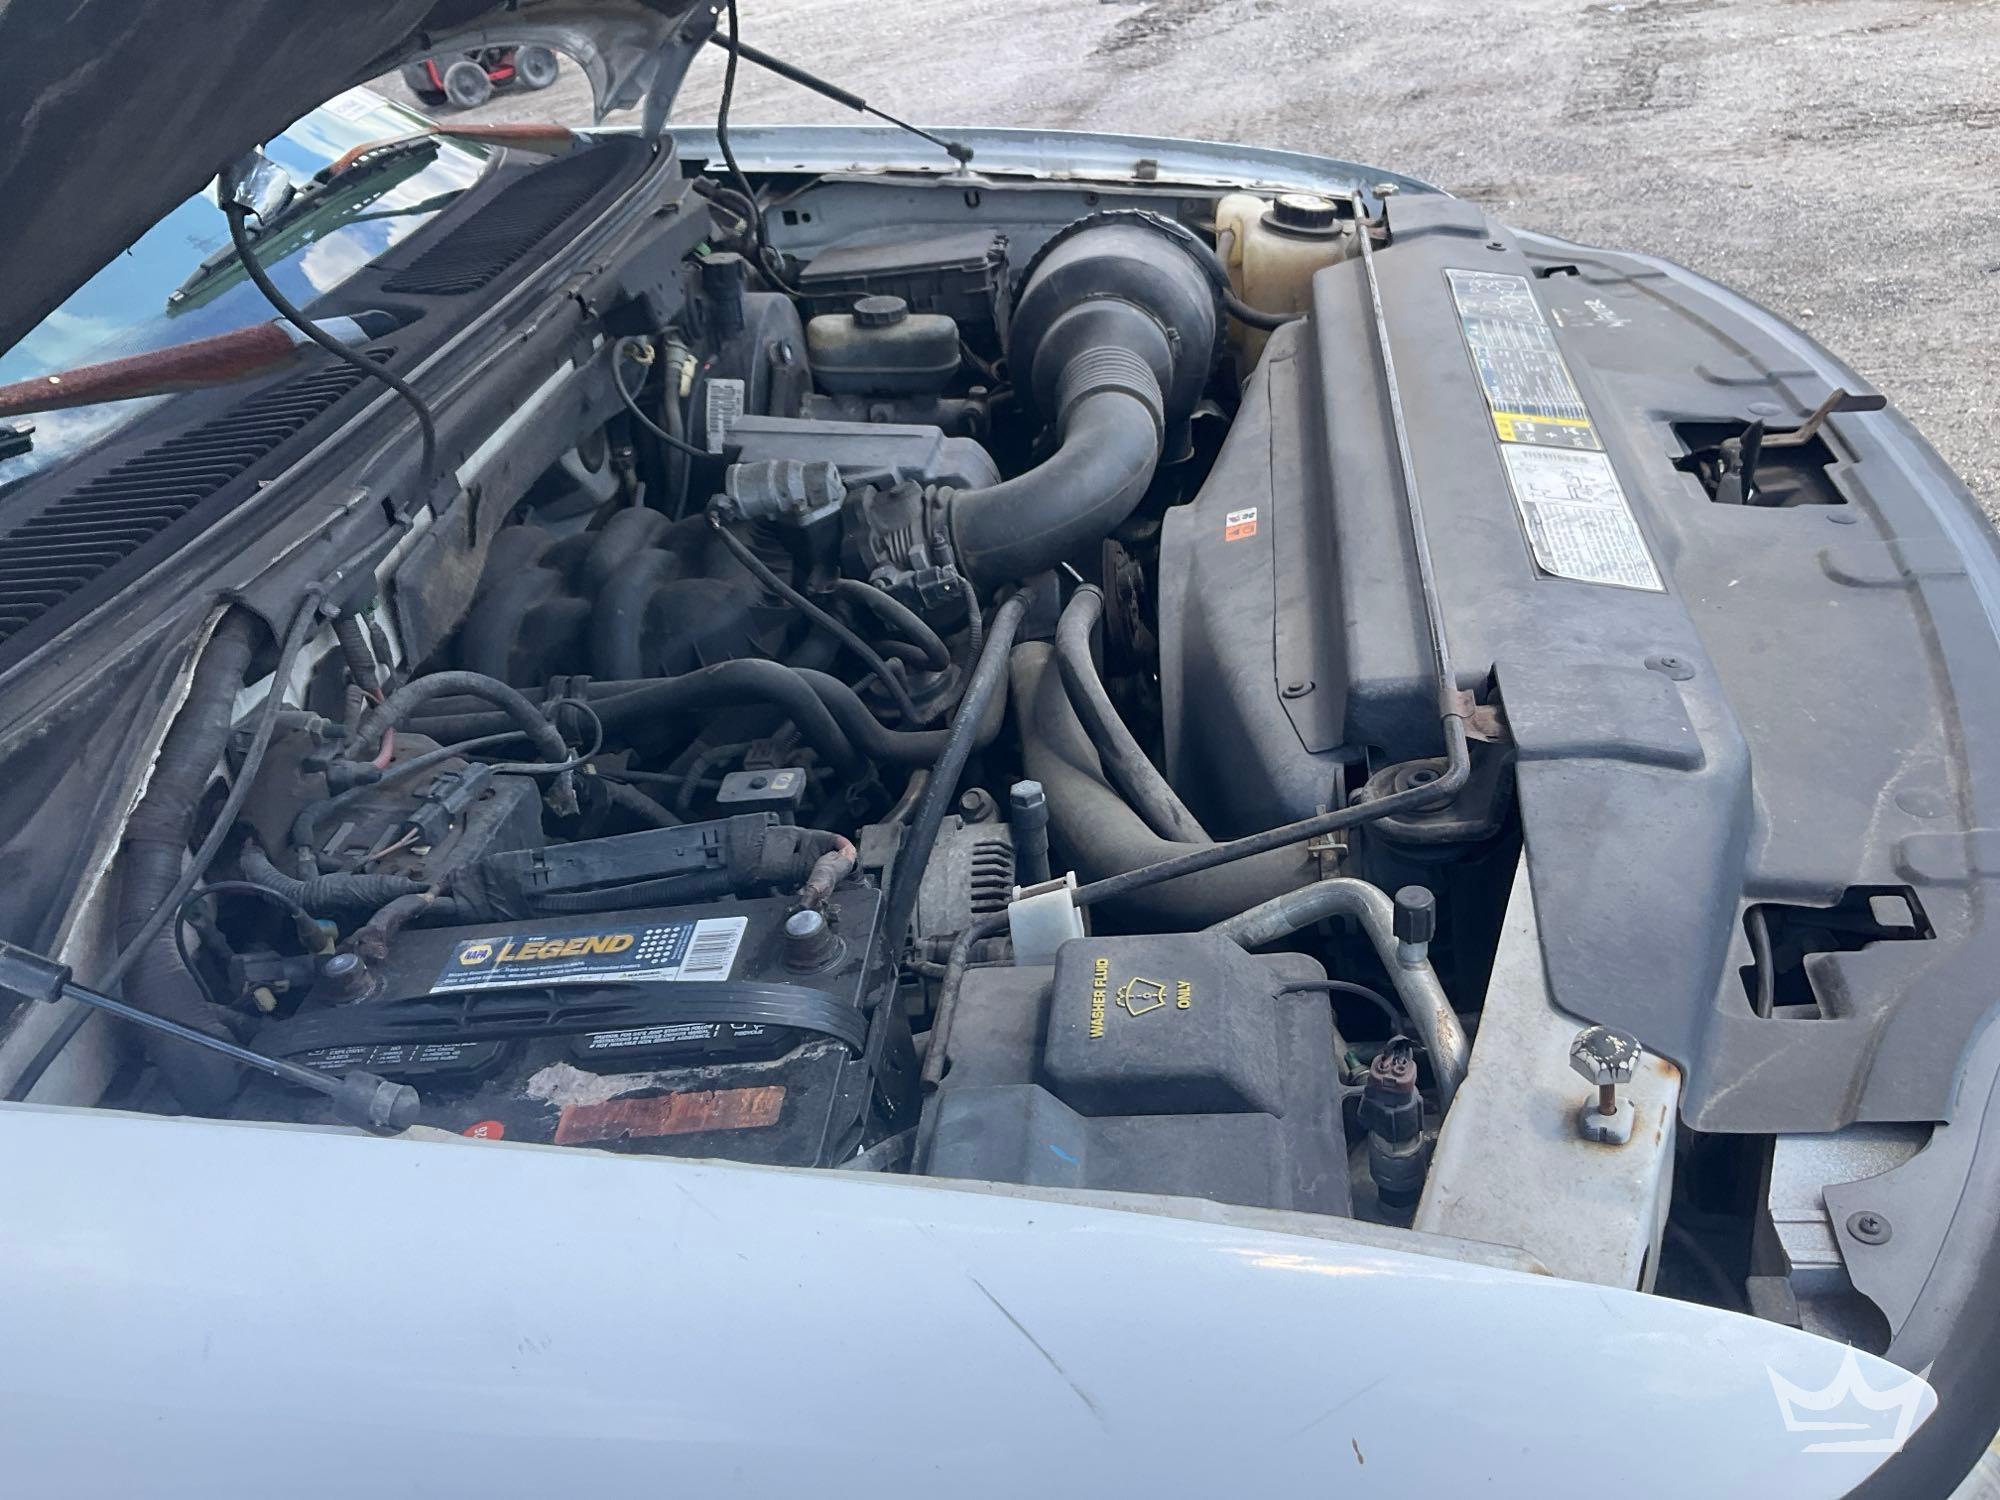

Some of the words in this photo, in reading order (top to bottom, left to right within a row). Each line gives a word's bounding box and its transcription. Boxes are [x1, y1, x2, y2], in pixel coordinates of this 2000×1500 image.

[464, 949, 488, 960] NAPA
[495, 934, 634, 962] LEGEND
[1094, 958, 1109, 988] FLUID
[1176, 980, 1191, 1009] ONLY
[1090, 990, 1106, 1039] WASHER
